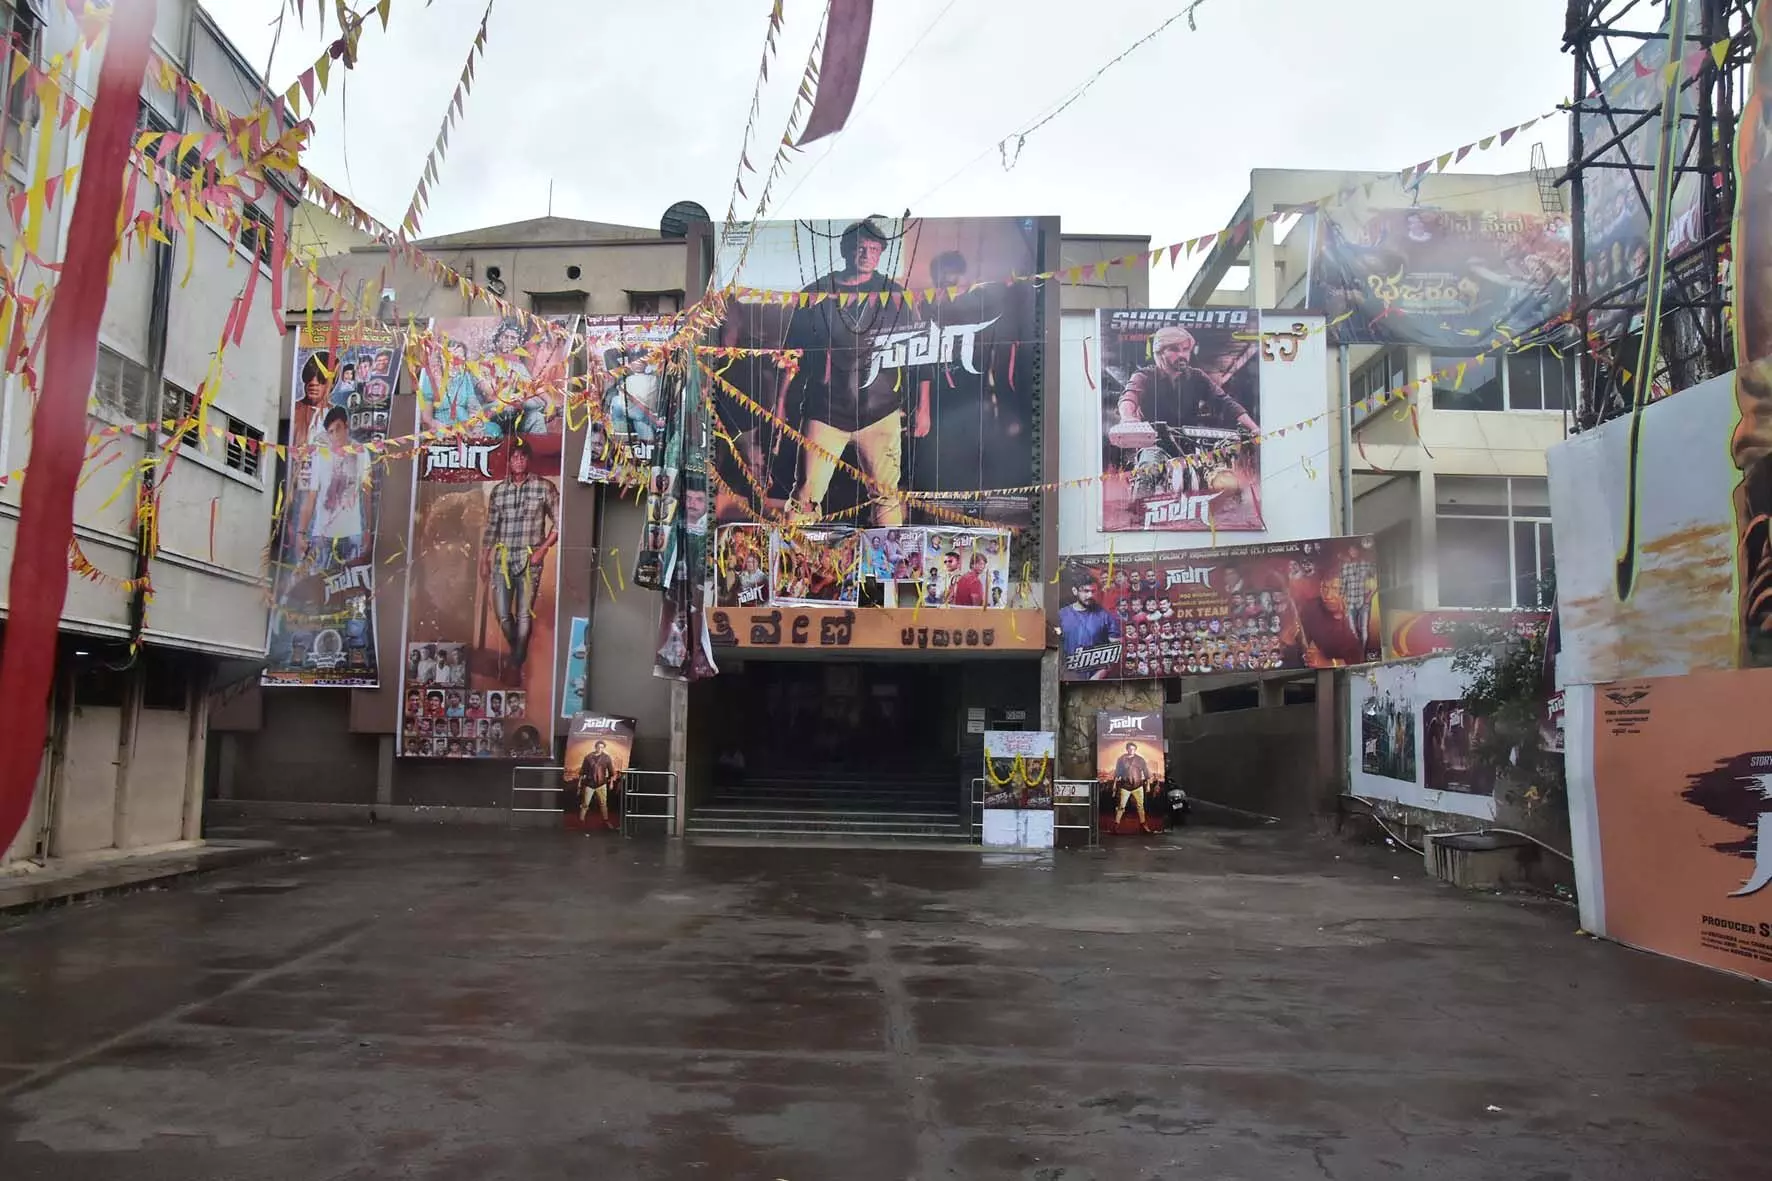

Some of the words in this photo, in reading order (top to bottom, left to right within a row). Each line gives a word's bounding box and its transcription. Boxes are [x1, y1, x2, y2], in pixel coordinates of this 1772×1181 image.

[859, 316, 1001, 389] ಸಲಗ
[424, 442, 504, 478] ಸಲಗ
[1144, 490, 1224, 531] ಸಲಗ
[1165, 565, 1217, 590] ಸಲಗ
[1197, 605, 1229, 617] TEAM
[710, 610, 855, 647] ತ್ರಿವೇಣಿ
[580, 716, 624, 732] ಸಲಗ
[1108, 715, 1150, 734] ಸಲಗ
[1702, 915, 1756, 934] PRODUCER
